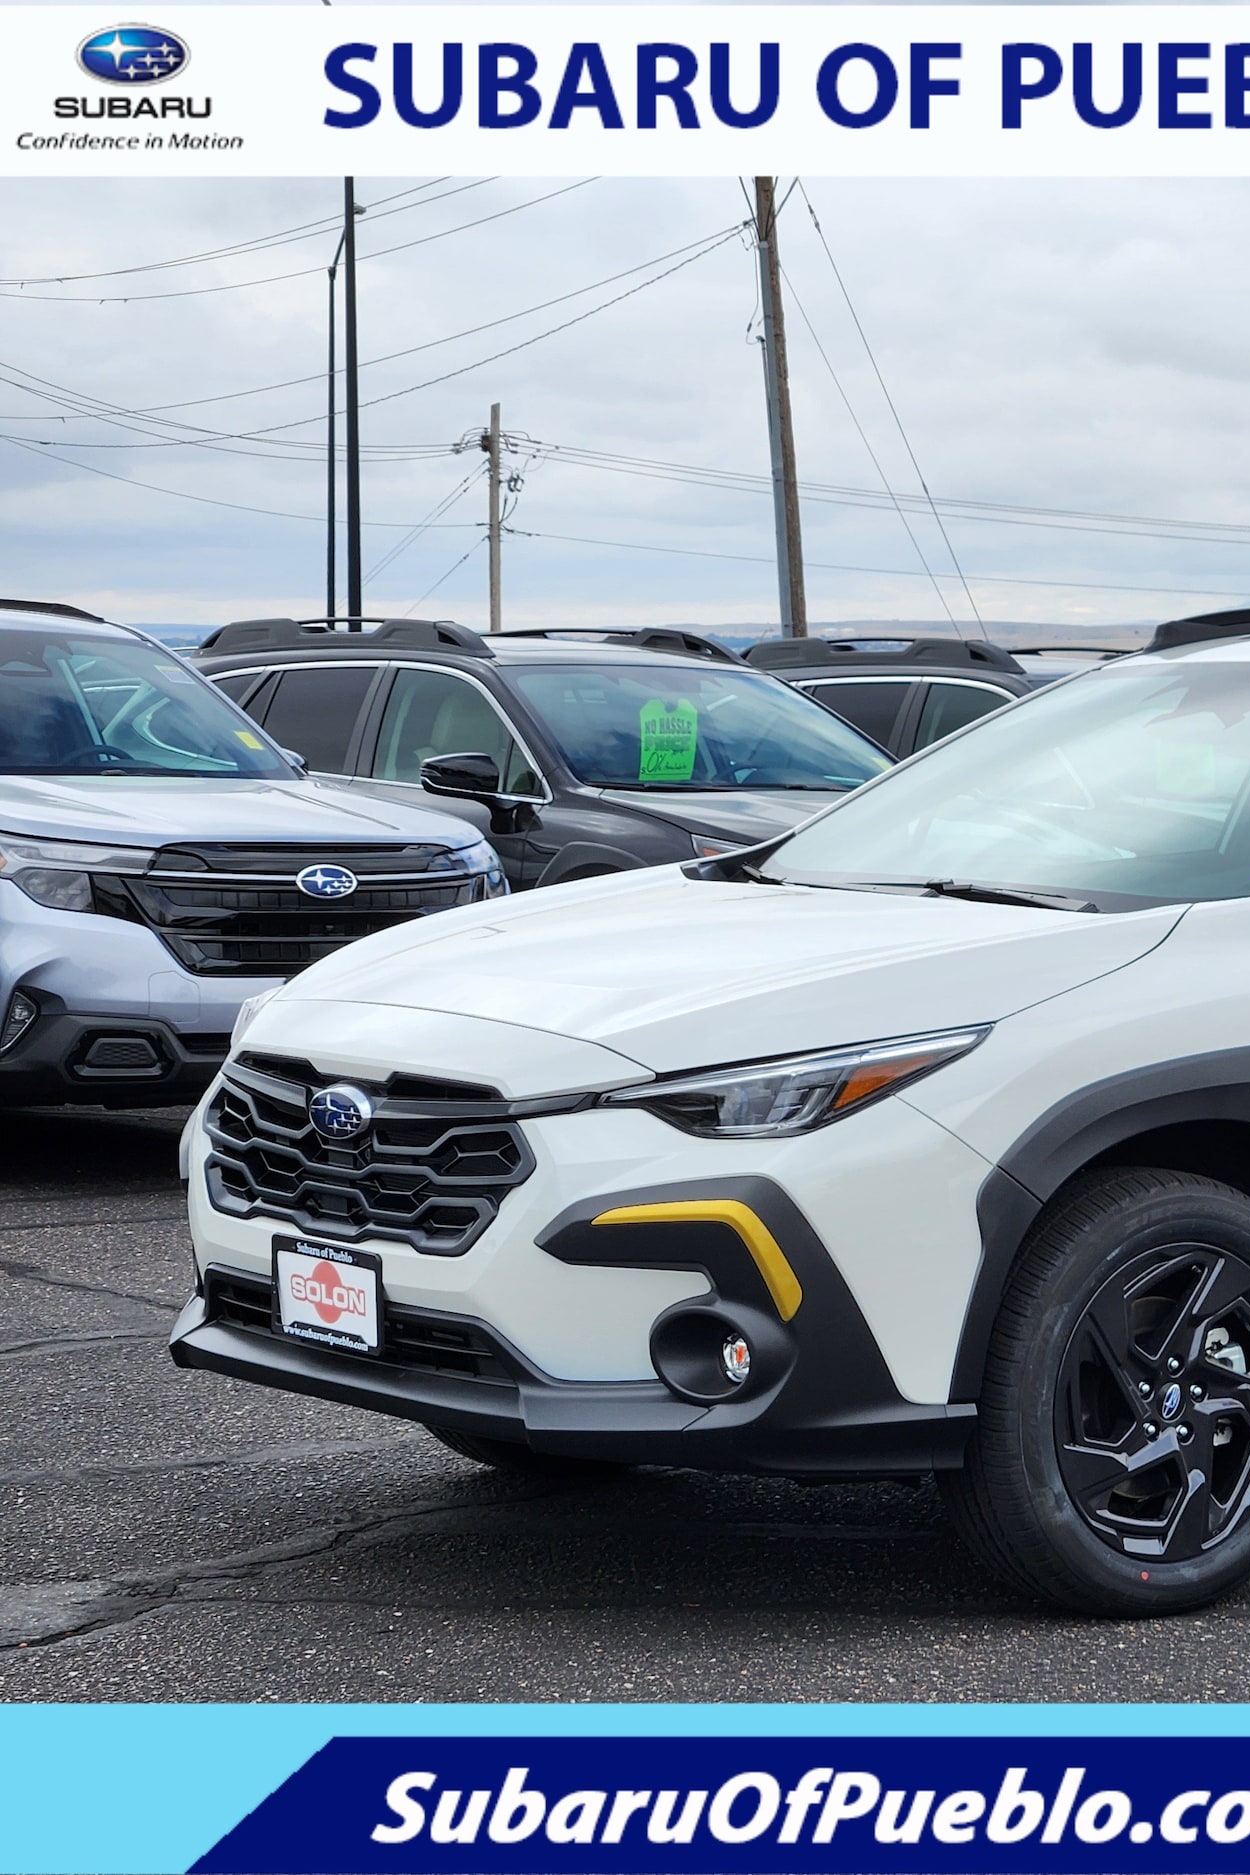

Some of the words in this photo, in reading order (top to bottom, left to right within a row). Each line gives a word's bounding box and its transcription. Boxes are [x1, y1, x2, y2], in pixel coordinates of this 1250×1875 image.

[296, 1242, 321, 1257] Subaru
[320, 1247, 329, 1258] of
[329, 1249, 354, 1263] Pueblo
[291, 1273, 366, 1317] SOLON
[283, 1325, 369, 1352] www.subaruofpueblo.com
